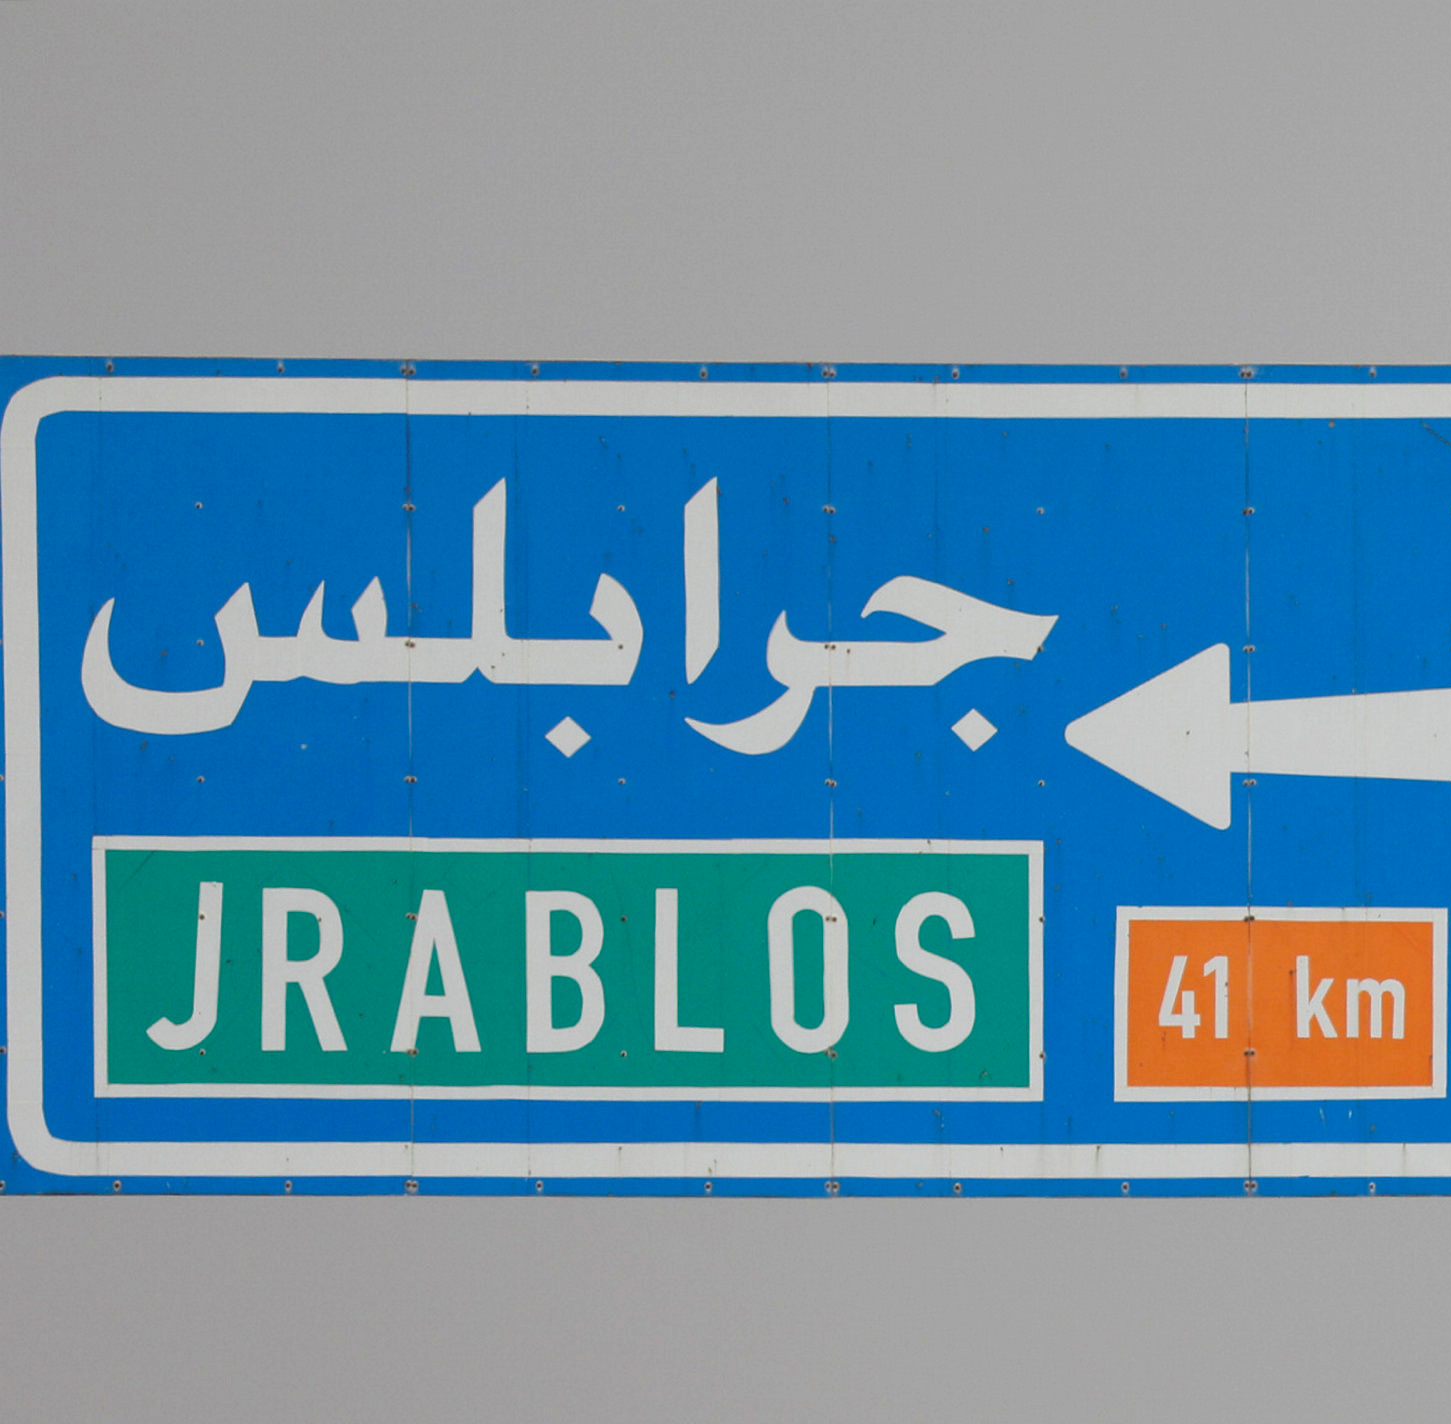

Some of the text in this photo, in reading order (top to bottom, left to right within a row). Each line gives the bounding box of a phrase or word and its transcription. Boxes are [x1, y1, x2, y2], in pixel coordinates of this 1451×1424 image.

[81, 477, 1059, 758] جرابلس
[146, 881, 976, 1053] JRABLOS
[1158, 954, 1406, 1040] 41 km
